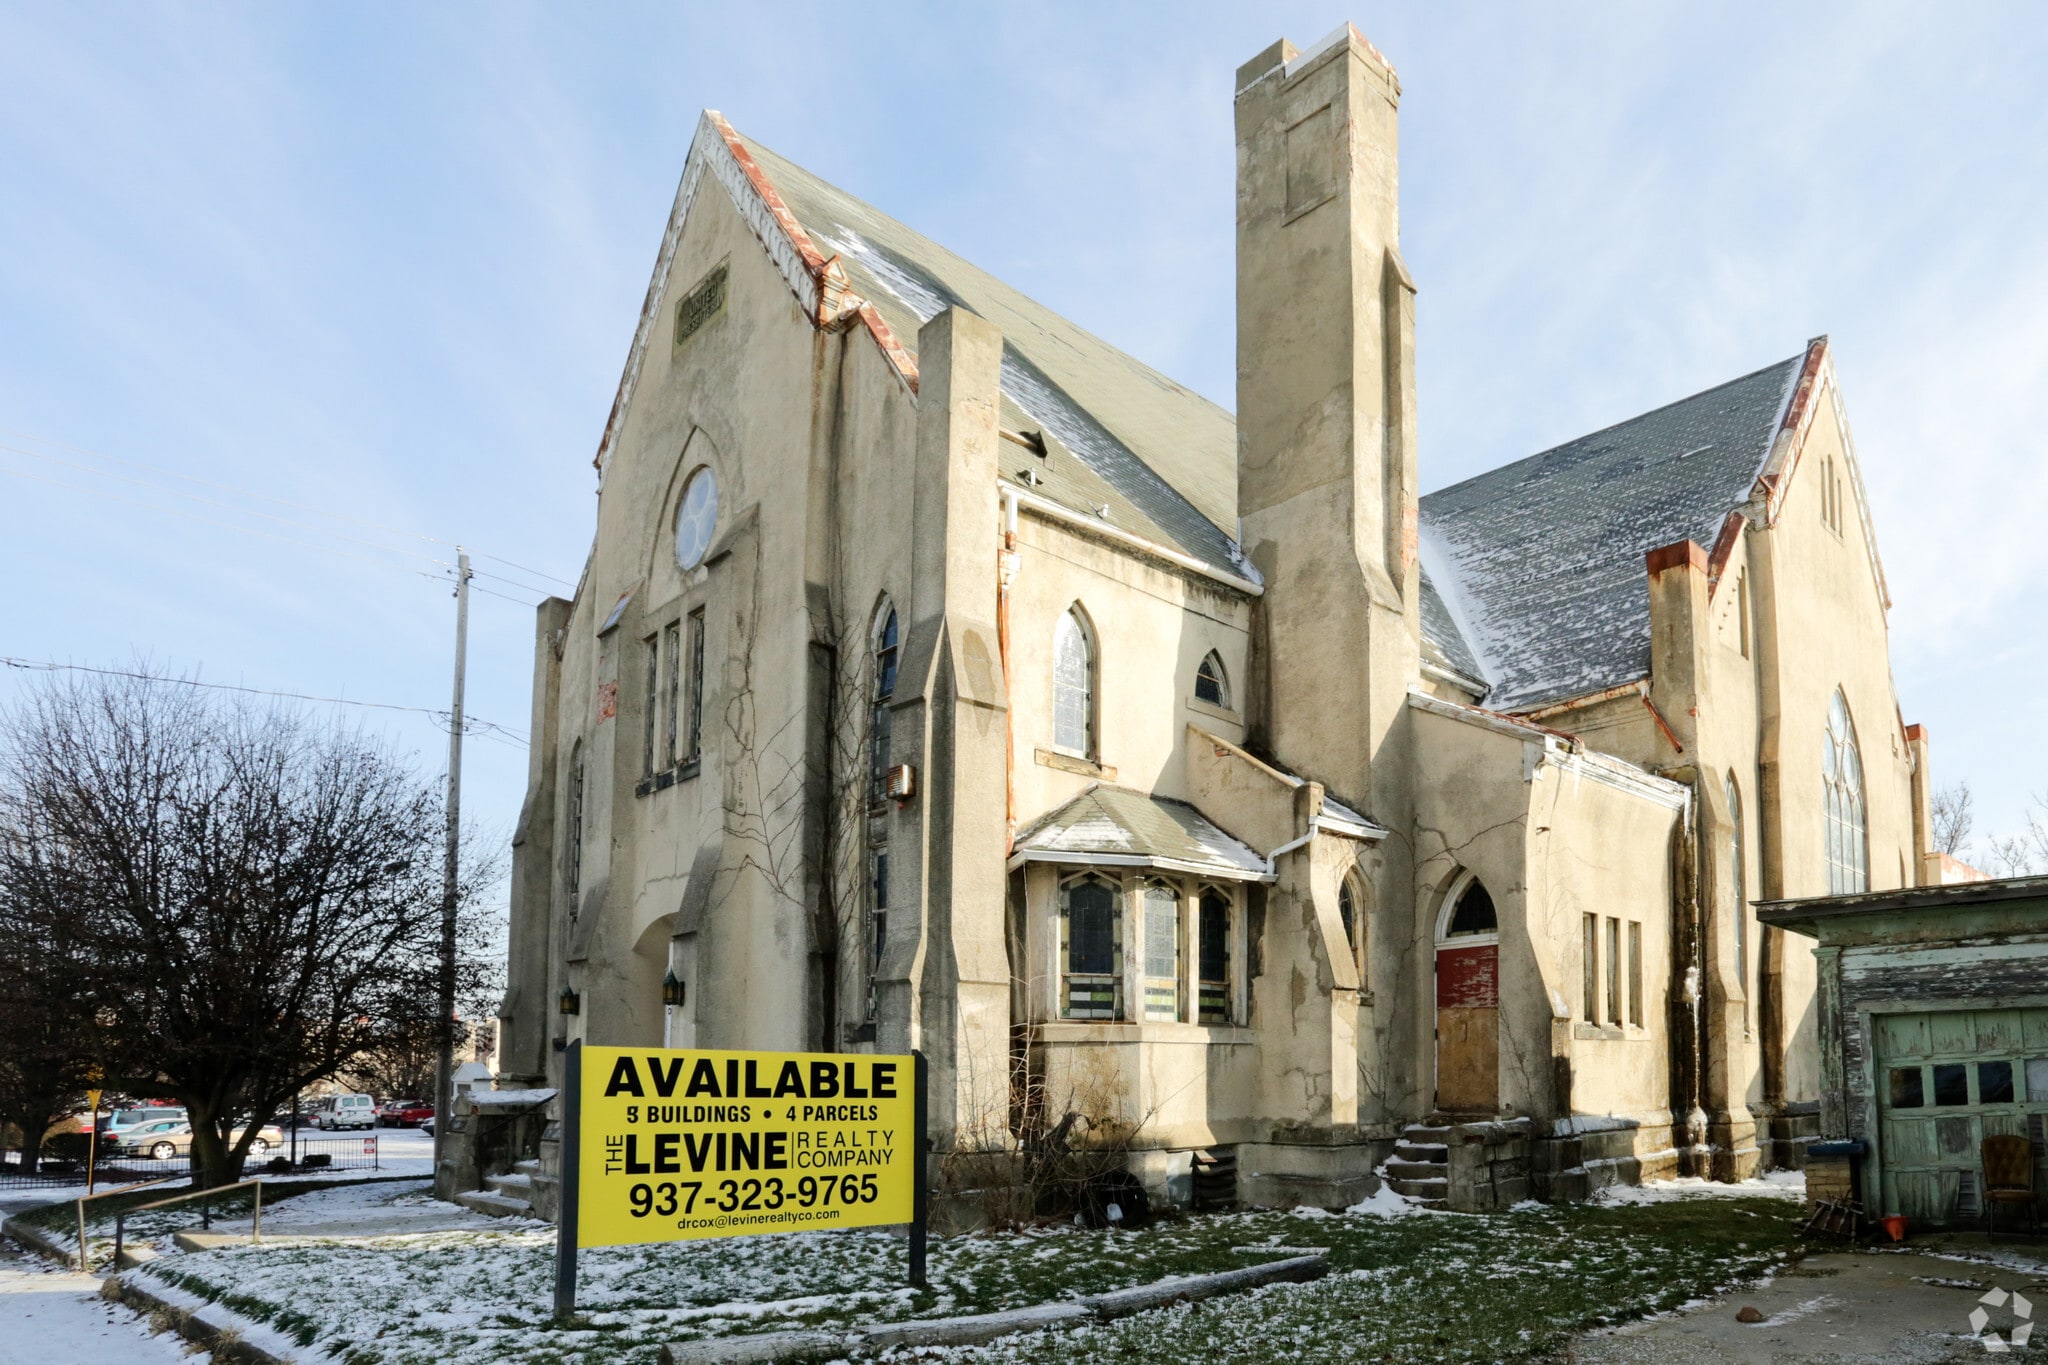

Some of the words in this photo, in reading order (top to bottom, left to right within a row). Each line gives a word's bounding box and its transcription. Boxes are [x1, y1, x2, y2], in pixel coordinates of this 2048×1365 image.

[604, 1056, 897, 1098] AVAILABLE
[647, 1106, 750, 1123] BUILDINGS
[786, 1106, 796, 1121] 4
[804, 1105, 877, 1121] PARCELS
[625, 1132, 787, 1175] LEVINE
[798, 1130, 893, 1148] REALTY
[606, 1135, 623, 1176] THE
[797, 1149, 894, 1169] COMPANY
[629, 1173, 878, 1218] 937-323-9765
[677, 1209, 840, 1230] drcox@levinerealtyco.com
